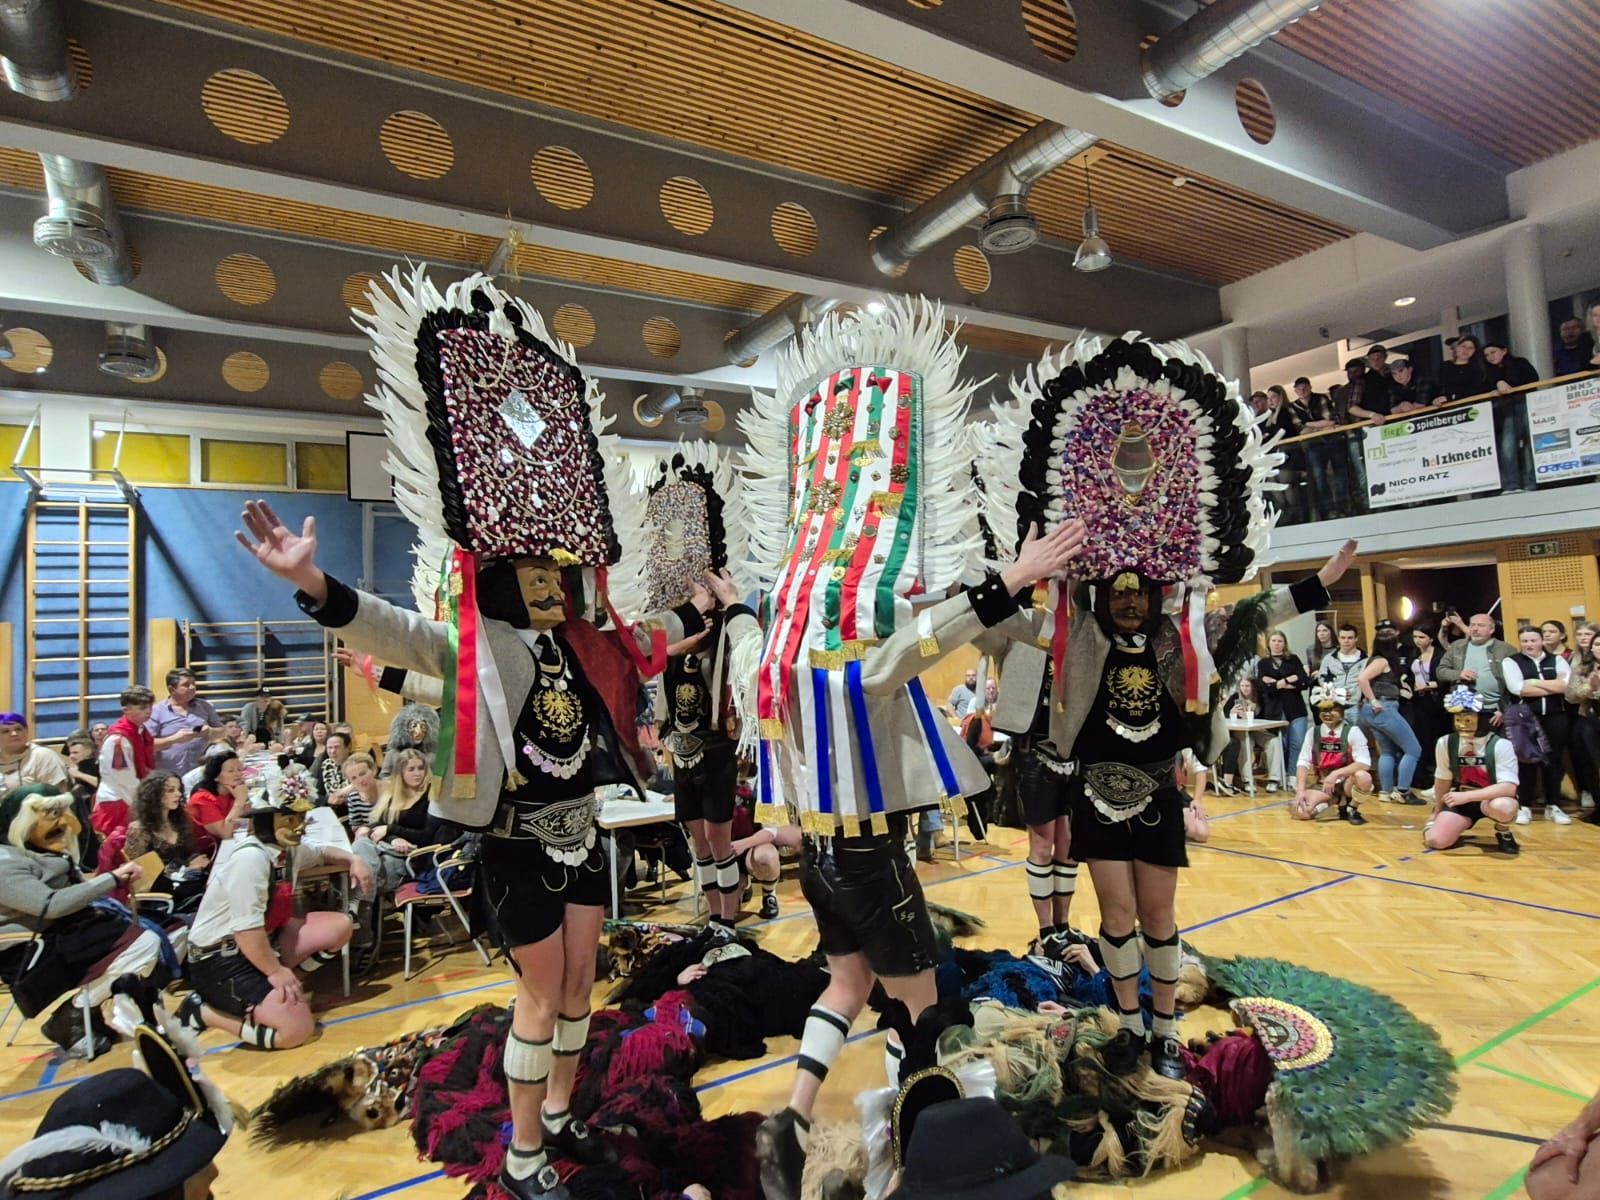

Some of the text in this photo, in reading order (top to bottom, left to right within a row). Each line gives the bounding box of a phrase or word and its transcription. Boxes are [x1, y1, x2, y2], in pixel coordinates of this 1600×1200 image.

[1416, 412, 1467, 431] spielberger
[1422, 446, 1493, 468] holzknecht
[1389, 472, 1449, 487] NICO RATZ
